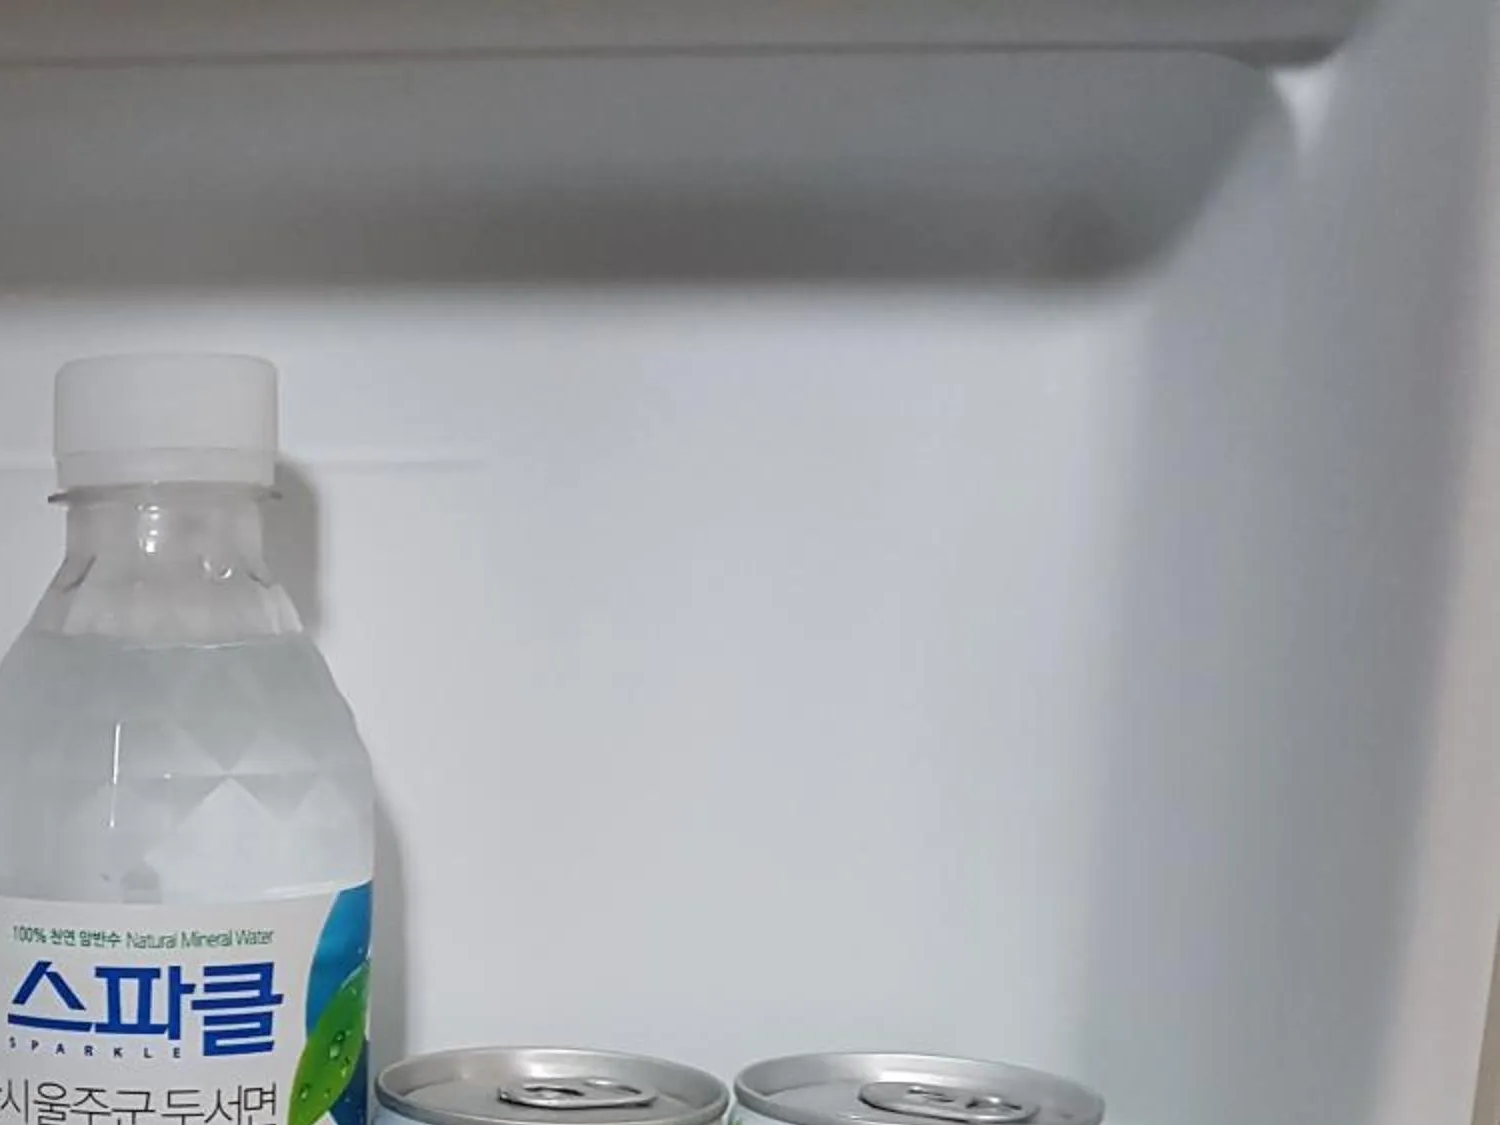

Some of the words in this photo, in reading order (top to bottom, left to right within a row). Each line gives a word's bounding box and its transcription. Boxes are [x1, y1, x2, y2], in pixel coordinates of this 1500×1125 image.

[12, 926, 47, 945] 100%
[50, 928, 77, 946] 천연
[79, 930, 121, 948] 암반수
[126, 932, 177, 949] Natural
[181, 930, 233, 948] Mineral
[235, 928, 275, 946] Water
[7, 960, 284, 1057] 스파클
[8, 1036, 181, 1059] SPARKLE
